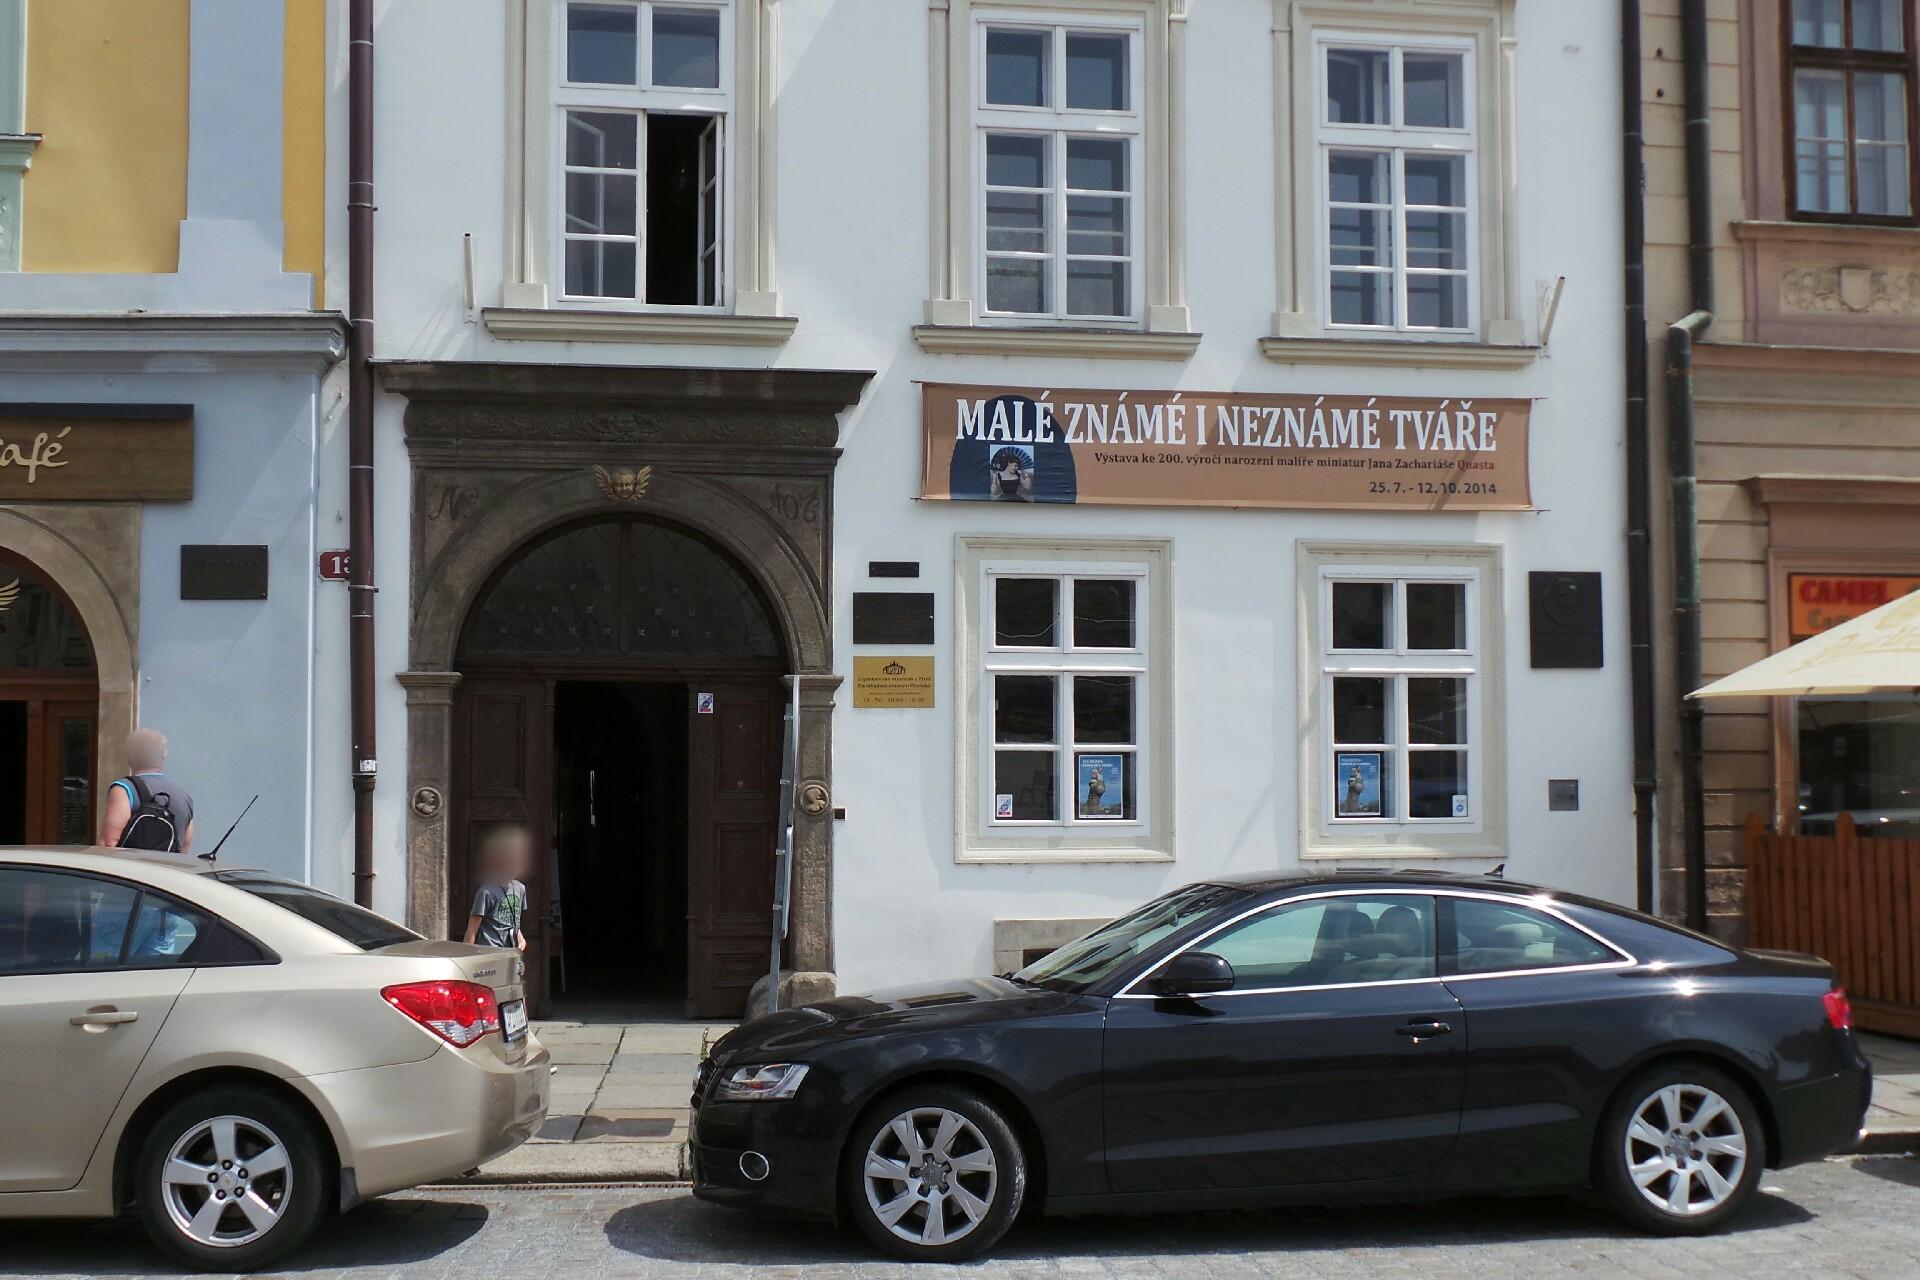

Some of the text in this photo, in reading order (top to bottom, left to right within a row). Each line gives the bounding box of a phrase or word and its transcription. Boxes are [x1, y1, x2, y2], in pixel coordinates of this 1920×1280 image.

[956, 390, 1497, 452] MALÉ ZNÁMÉ I NEZNÁMÉ TVÁŘE
[0, 426, 72, 483] afé
[1094, 452, 1139, 465] Výstava
[1141, 452, 1156, 464] ke
[1158, 453, 1184, 465] 200.
[1186, 453, 1222, 466] výročí
[1224, 454, 1274, 466] narození
[1316, 456, 1366, 468] miniatur
[1367, 457, 1393, 470] Jana
[1395, 457, 1455, 470] Zachariáše
[1457, 459, 1495, 472] Quasta
[1464, 482, 1497, 495] 2014
